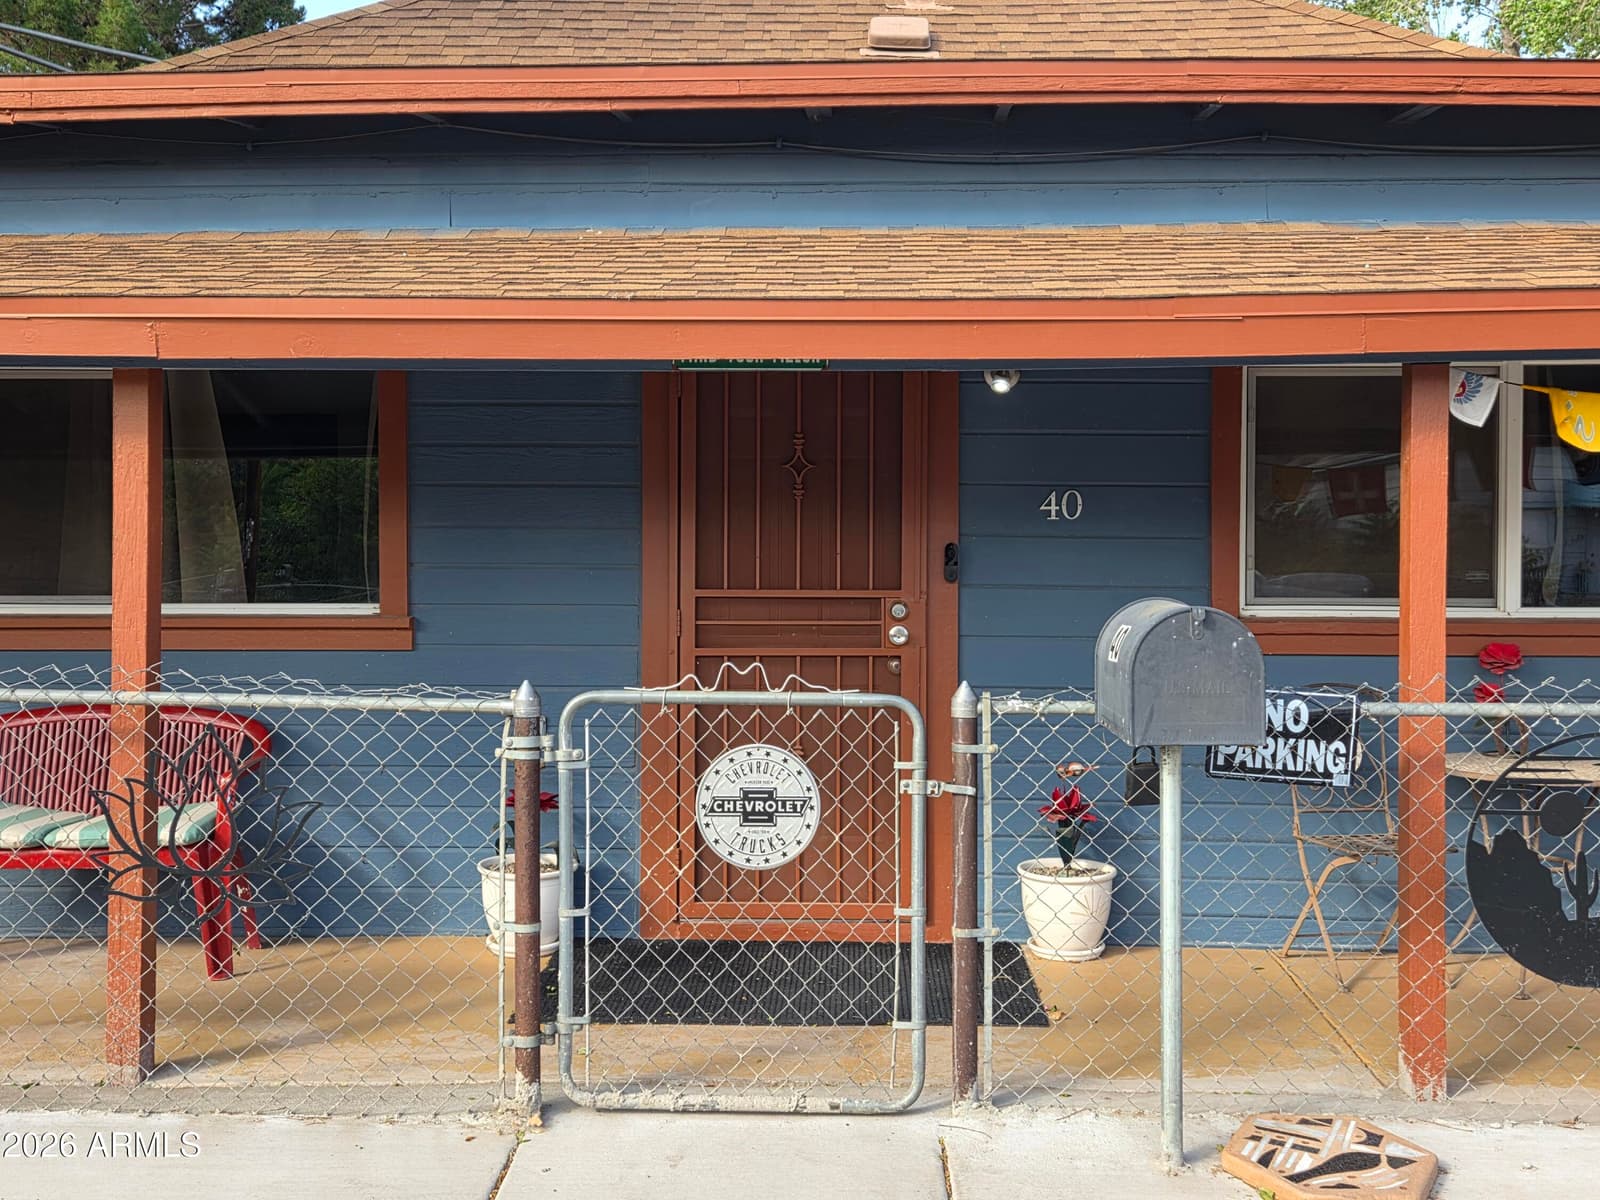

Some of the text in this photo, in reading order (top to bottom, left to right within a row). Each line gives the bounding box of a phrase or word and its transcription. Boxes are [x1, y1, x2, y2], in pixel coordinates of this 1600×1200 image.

[1039, 489, 1083, 520] 40
[1265, 698, 1310, 734] NO
[1216, 738, 1347, 774] PARKING
[725, 760, 791, 784] CHEVROLET
[713, 800, 804, 812] CHEVROLET
[730, 832, 786, 853] TRUCKS
